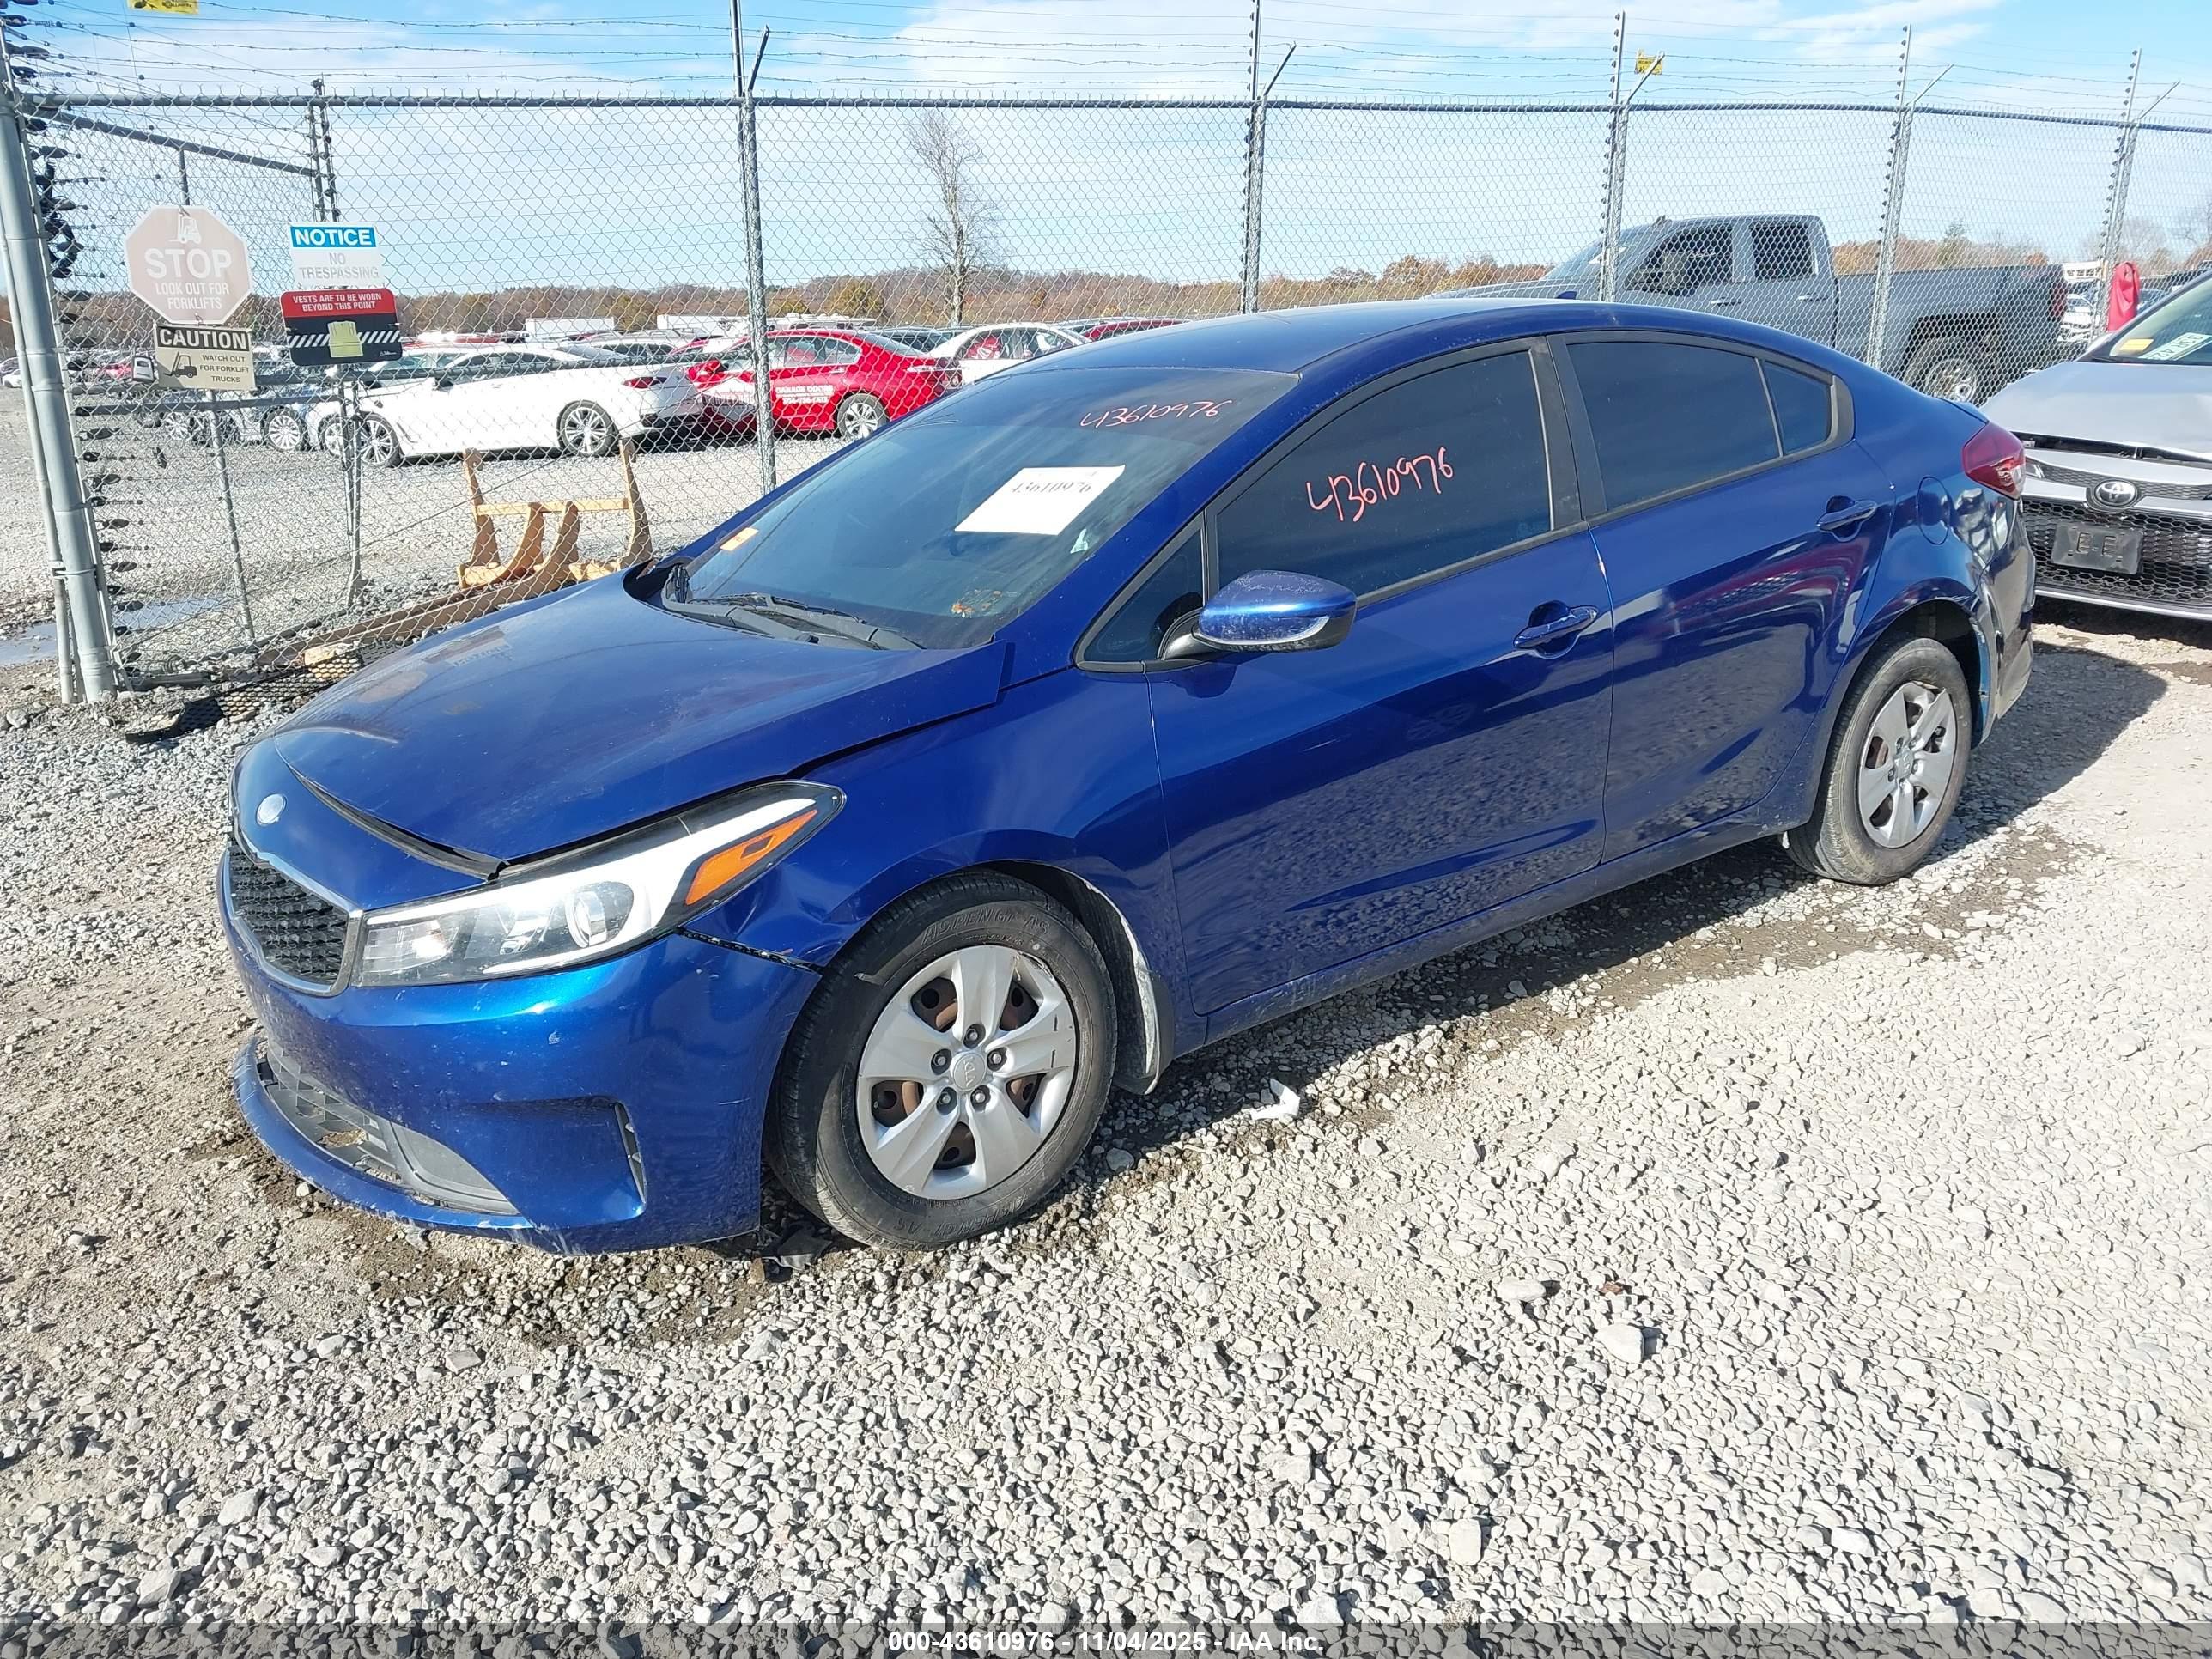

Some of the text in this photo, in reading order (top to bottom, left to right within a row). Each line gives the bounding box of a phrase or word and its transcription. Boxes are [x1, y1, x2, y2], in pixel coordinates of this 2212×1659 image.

[295, 229, 373, 246] NOTICE
[144, 248, 232, 278] STOP
[329, 252, 346, 265] NO
[299, 266, 379, 279] TRESPASSING
[155, 283, 230, 295] LOOK OUT FOR
[167, 297, 222, 309] FORKLIFTS
[293, 295, 318, 304] VESTS
[319, 295, 334, 303] ARE
[335, 294, 345, 302] TO
[358, 293, 382, 301] WORN
[302, 303, 333, 312] BEYOND
[160, 329, 247, 349] CAUTION
[1080, 400, 1232, 428] 43610976
[1305, 447, 1454, 522] 43610976
